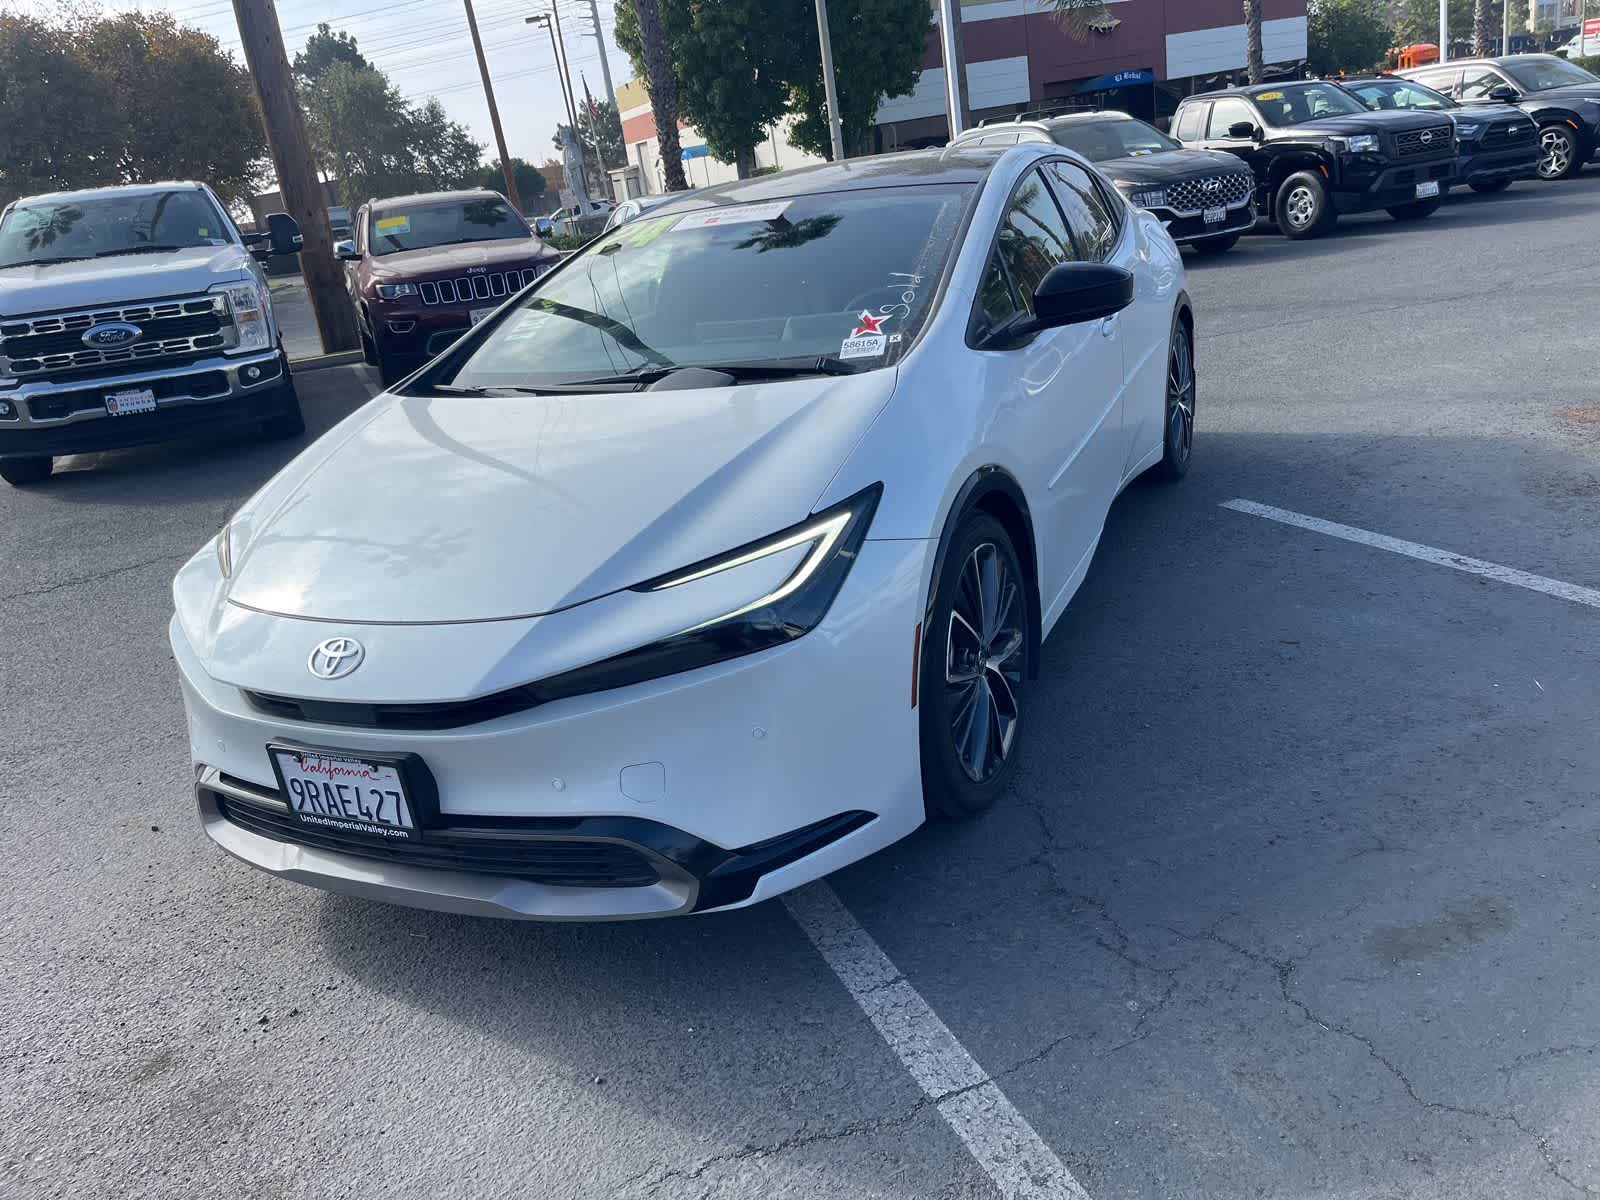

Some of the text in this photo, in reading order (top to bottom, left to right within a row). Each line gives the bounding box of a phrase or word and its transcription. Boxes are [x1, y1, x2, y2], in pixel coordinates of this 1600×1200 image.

[466, 266, 487, 274] Jeep
[99, 329, 126, 343] Ford
[300, 756, 380, 780] California
[289, 777, 403, 826] 9RAE427
[300, 814, 409, 838] UnitedImperialValley.com
